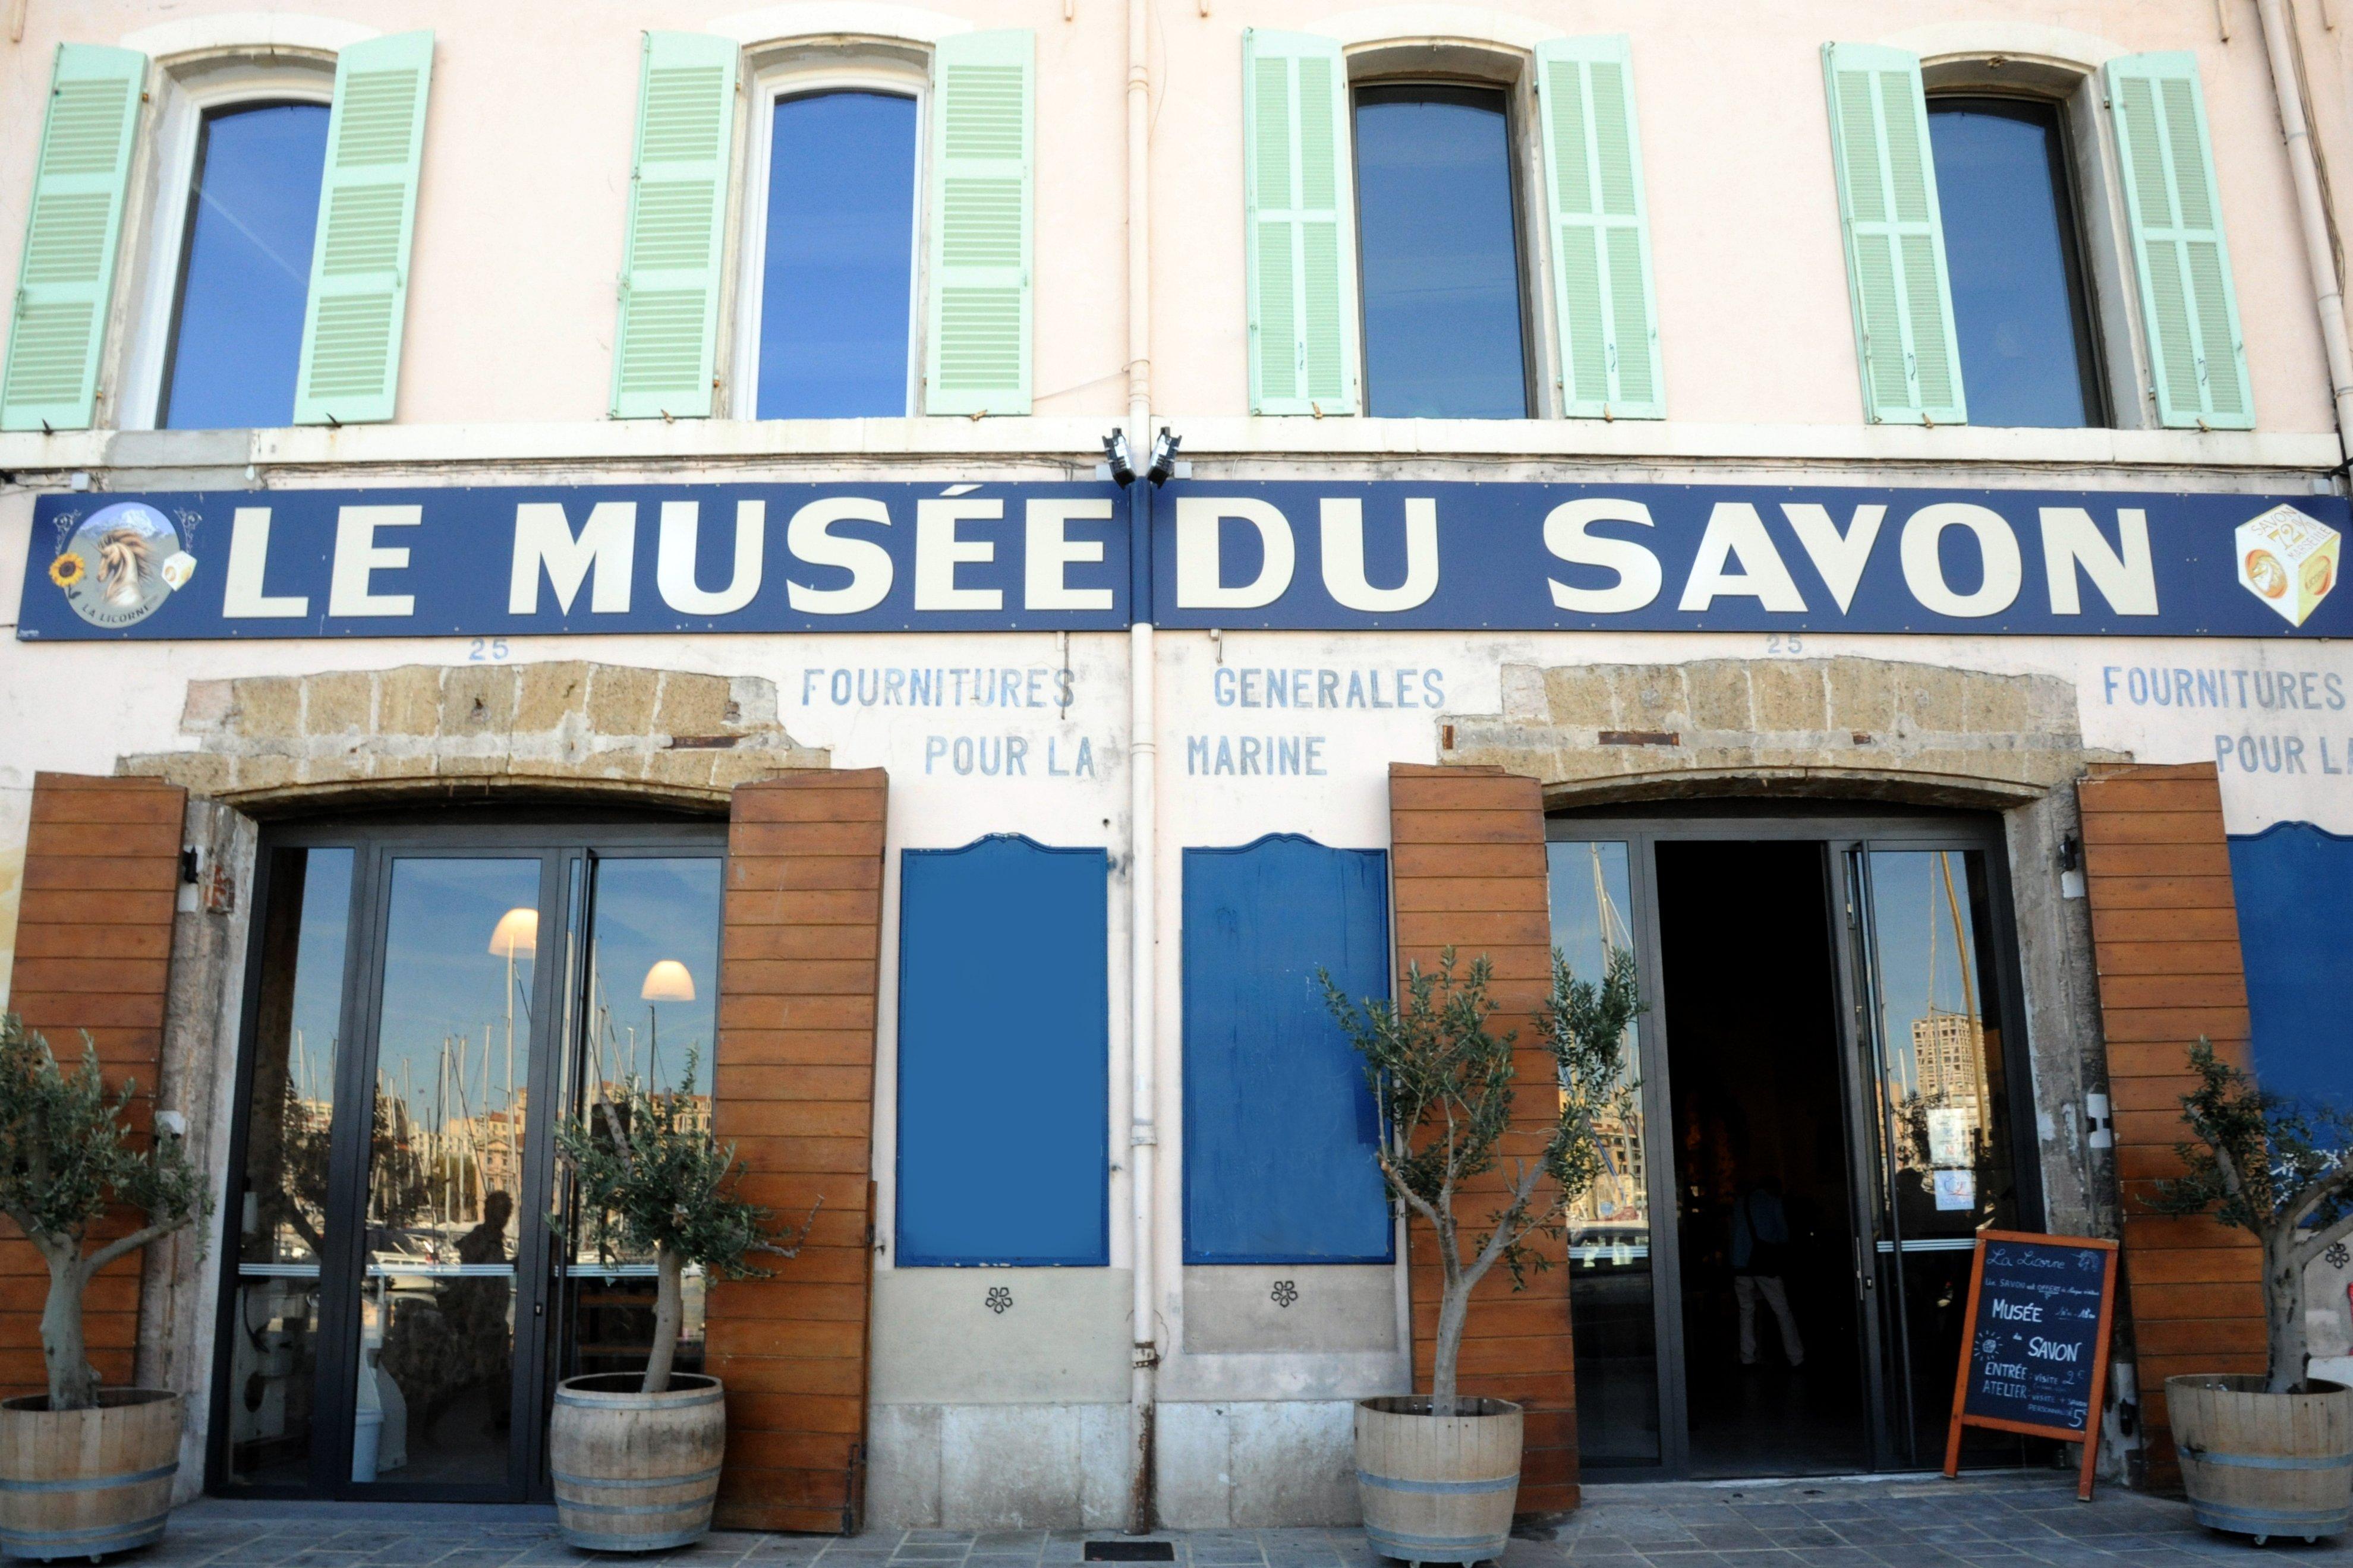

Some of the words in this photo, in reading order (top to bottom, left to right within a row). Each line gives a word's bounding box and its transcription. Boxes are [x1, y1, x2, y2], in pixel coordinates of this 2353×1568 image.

[2251, 507, 2297, 536] SAVON
[2267, 515, 2317, 550] 72%
[223, 504, 423, 617] LE
[509, 483, 1113, 616] MUSÉE
[1176, 497, 1439, 613] DU
[1543, 498, 2159, 617] SAVON
[2288, 525, 2332, 560] MARSEILLE
[82, 604, 96, 618] LA
[469, 638, 509, 661] 25
[1766, 634, 1803, 654] 25
[802, 668, 1076, 708] FOURNITURES
[1214, 667, 1445, 709] GENERALES
[2103, 665, 2346, 711] FOURNITURES
[925, 736, 1029, 776] POUR
[1048, 736, 1096, 778] LA
[1187, 736, 1327, 775] MARINE
[2215, 734, 2307, 774] POUR
[1986, 1248, 2013, 1267] La
[2017, 1250, 2065, 1269] Licorne
[1999, 1278, 2026, 1289] SAVON
[2037, 1284, 2061, 1293] OFFERT
[1992, 1298, 2043, 1323] MUSÉE
[2027, 1336, 2082, 1362] SAVON
[1985, 1361, 2028, 1380] ENTRÉE
[1982, 1379, 2026, 1399] ATELIER
